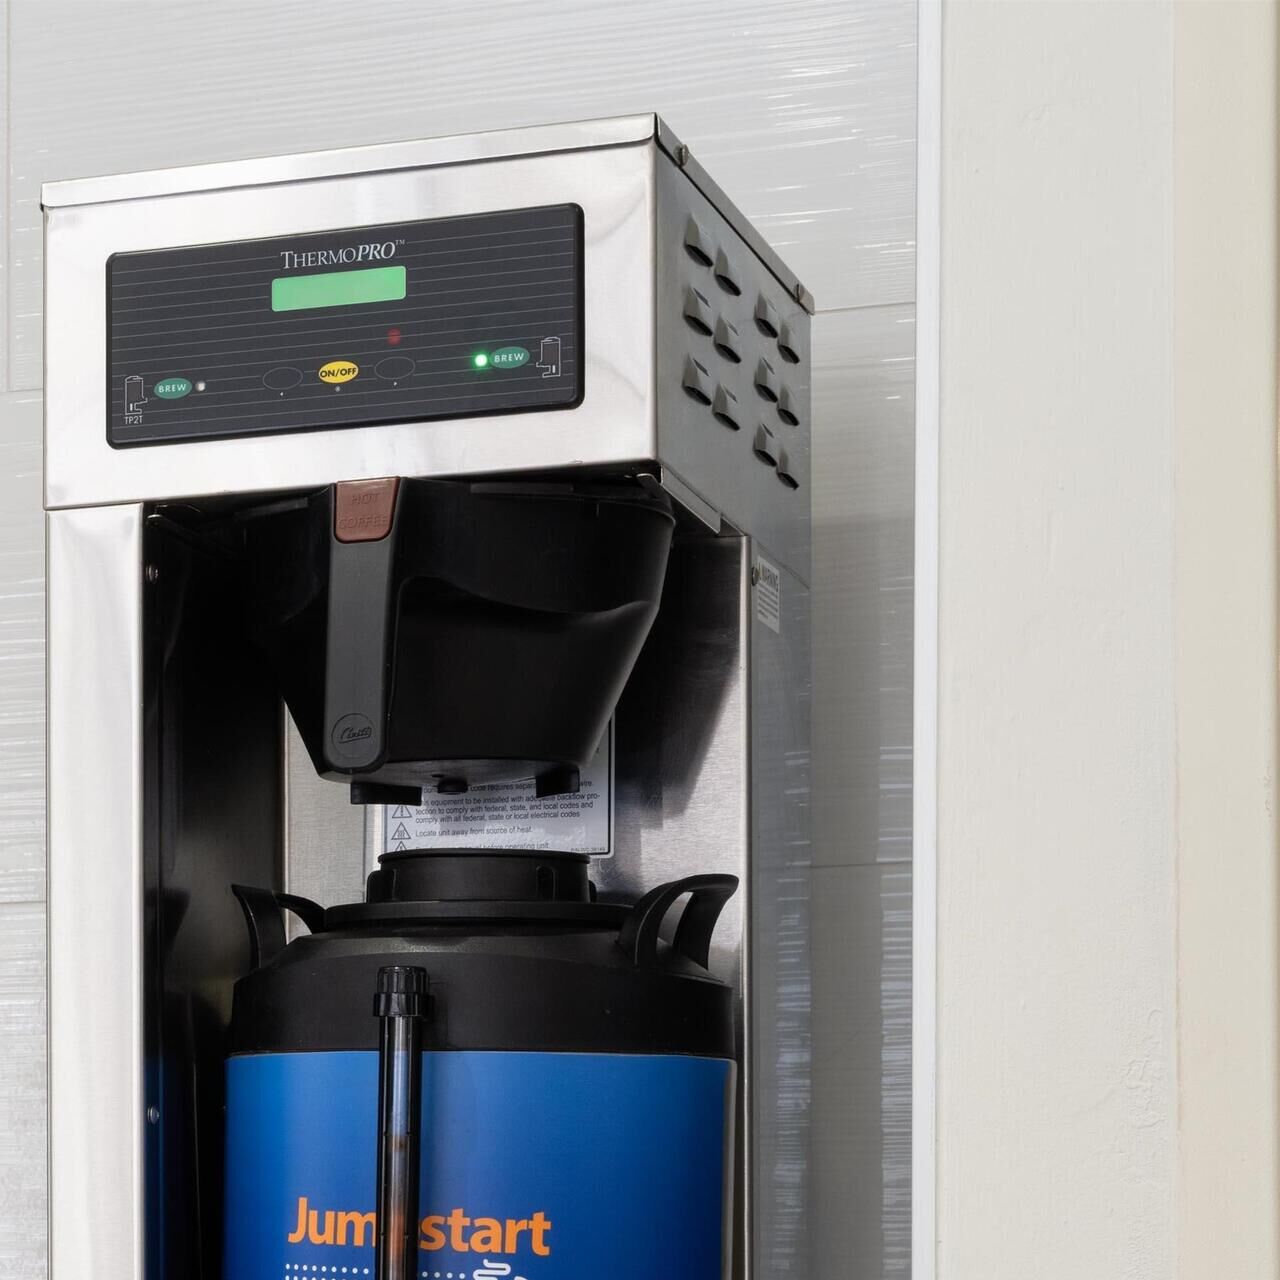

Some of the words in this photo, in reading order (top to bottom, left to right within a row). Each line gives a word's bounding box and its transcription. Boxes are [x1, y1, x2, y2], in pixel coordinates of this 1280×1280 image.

[493, 351, 524, 363] BREW
[319, 365, 358, 379] ON/OFF
[158, 383, 187, 393] BREW
[446, 806, 469, 815] comply
[288, 1197, 552, 1256] Jumstart
